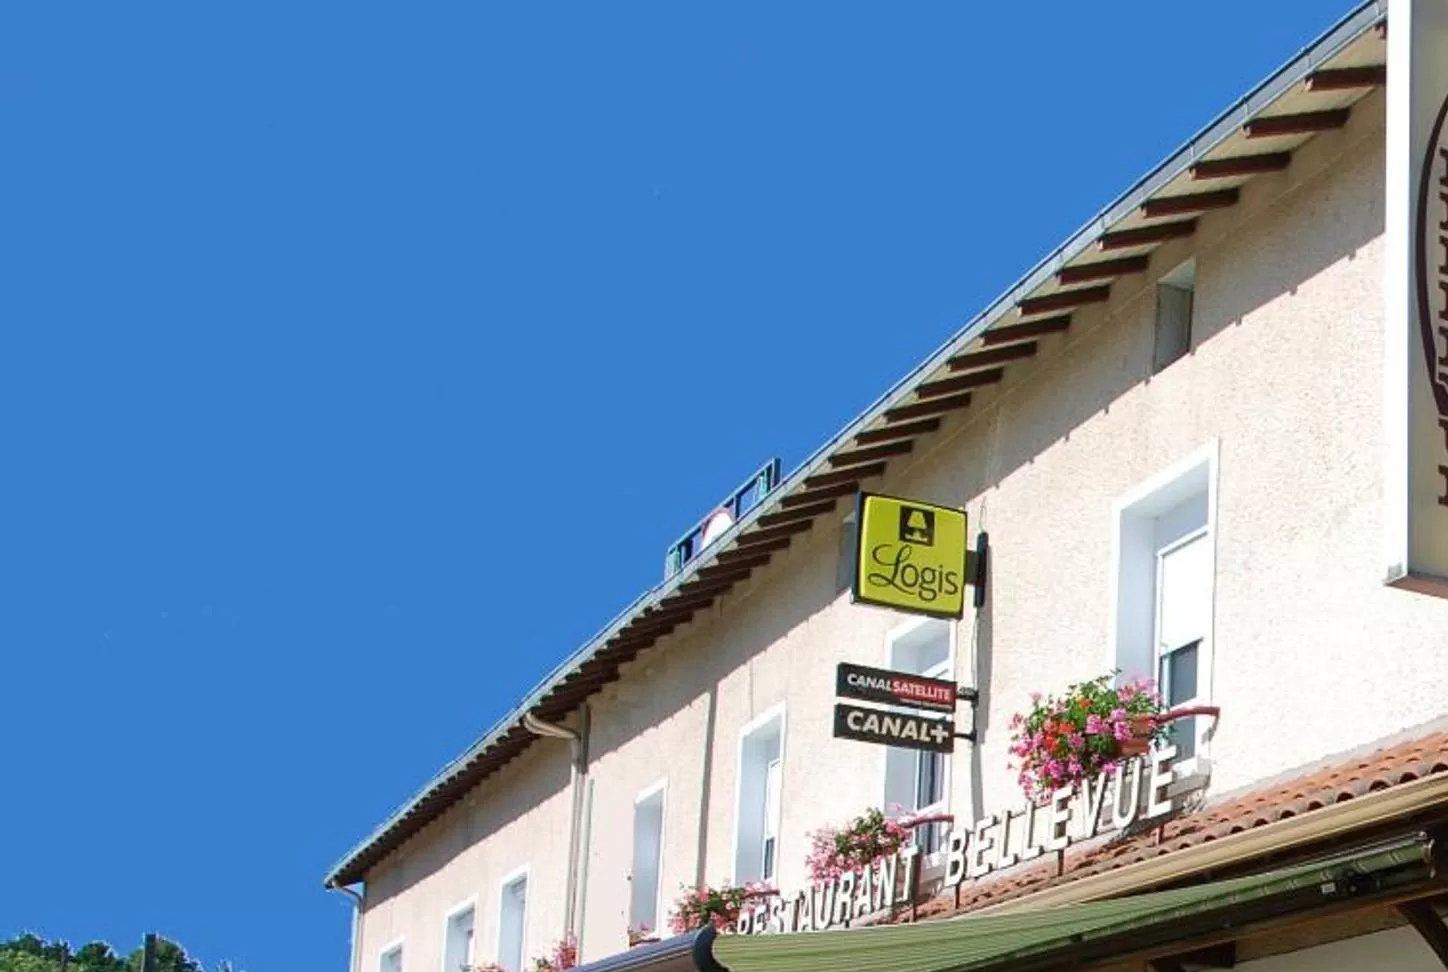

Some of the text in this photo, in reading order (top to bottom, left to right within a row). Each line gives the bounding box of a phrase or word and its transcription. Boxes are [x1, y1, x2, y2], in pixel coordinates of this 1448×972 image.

[867, 544, 959, 602] Logis
[846, 711, 949, 744] CANAL+
[737, 742, 1177, 936] RESTAURANT BELLEVUE
